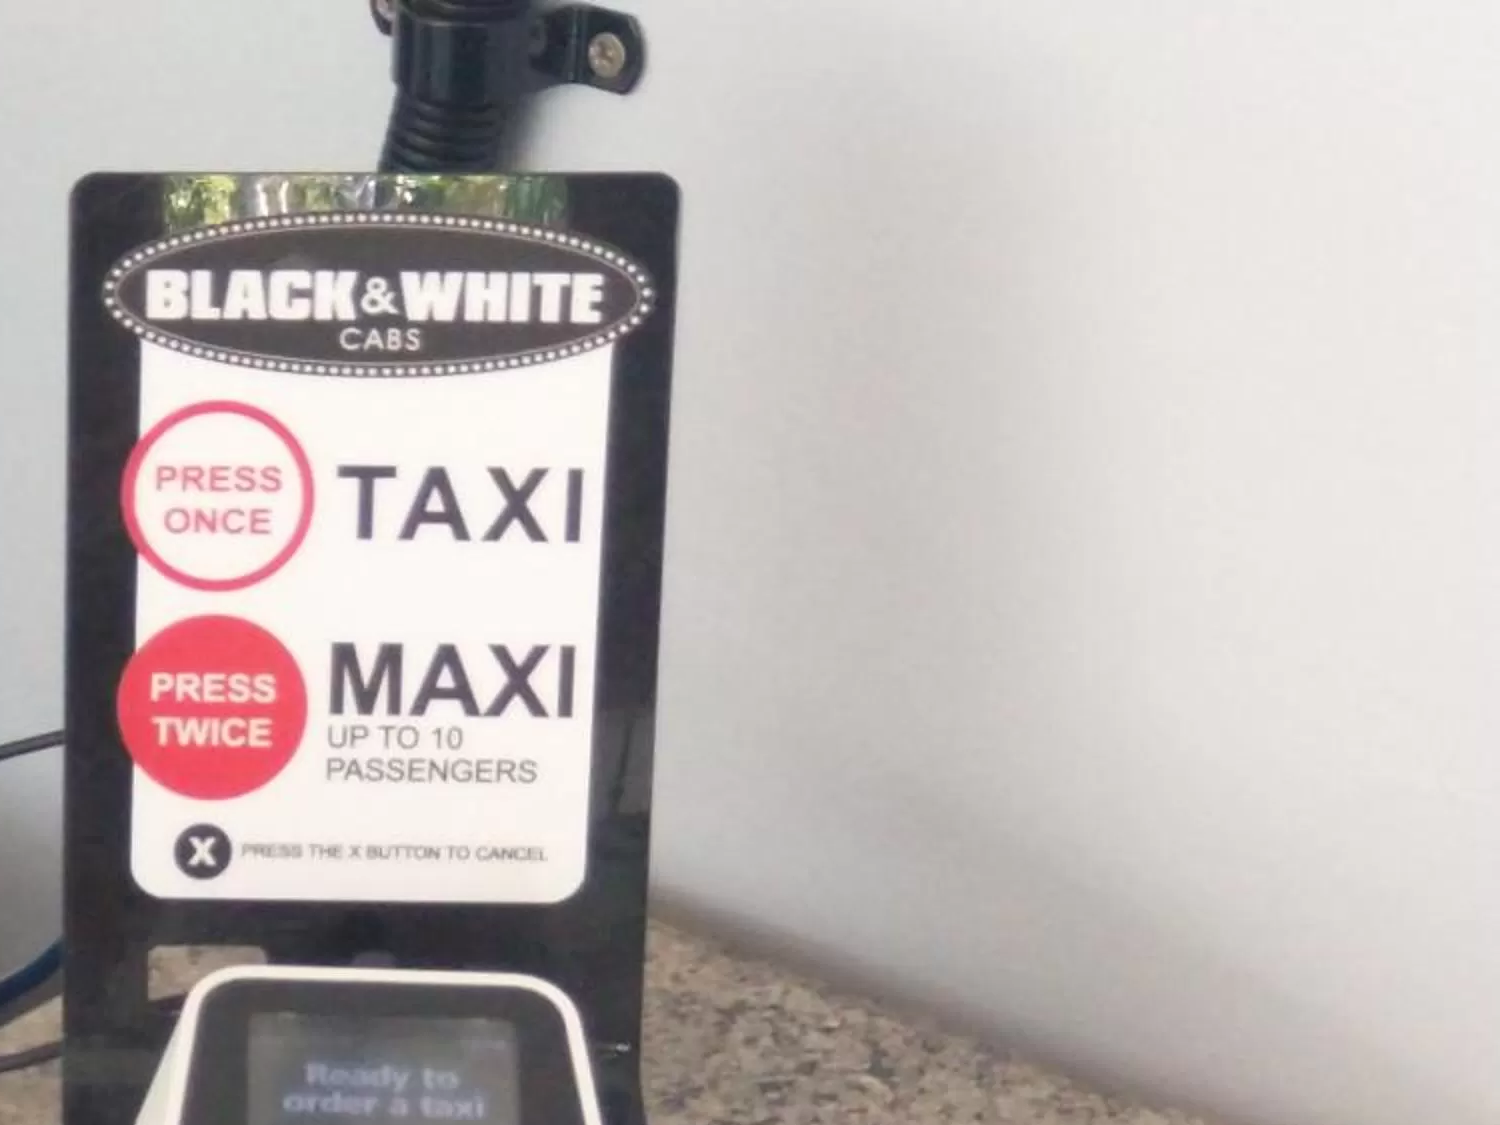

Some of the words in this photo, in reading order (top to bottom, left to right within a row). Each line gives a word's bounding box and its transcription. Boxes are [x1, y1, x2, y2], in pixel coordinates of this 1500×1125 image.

[340, 327, 422, 352] CABS
[155, 466, 283, 492] PRESS
[338, 465, 584, 543] TAXI
[164, 508, 272, 534] ONCE
[150, 673, 277, 703] PRESS
[329, 642, 576, 719] MAXI
[151, 717, 273, 748] TWICE
[327, 726, 371, 749] UP
[379, 726, 420, 749] TO
[430, 726, 463, 750] 10
[326, 758, 538, 784] PASSENGERS
[241, 842, 303, 860] PRESS
[308, 843, 342, 860] THE
[348, 844, 361, 860] X
[366, 845, 441, 862] BUTTON
[446, 846, 470, 862] TO
[475, 846, 549, 863] CANCEL
